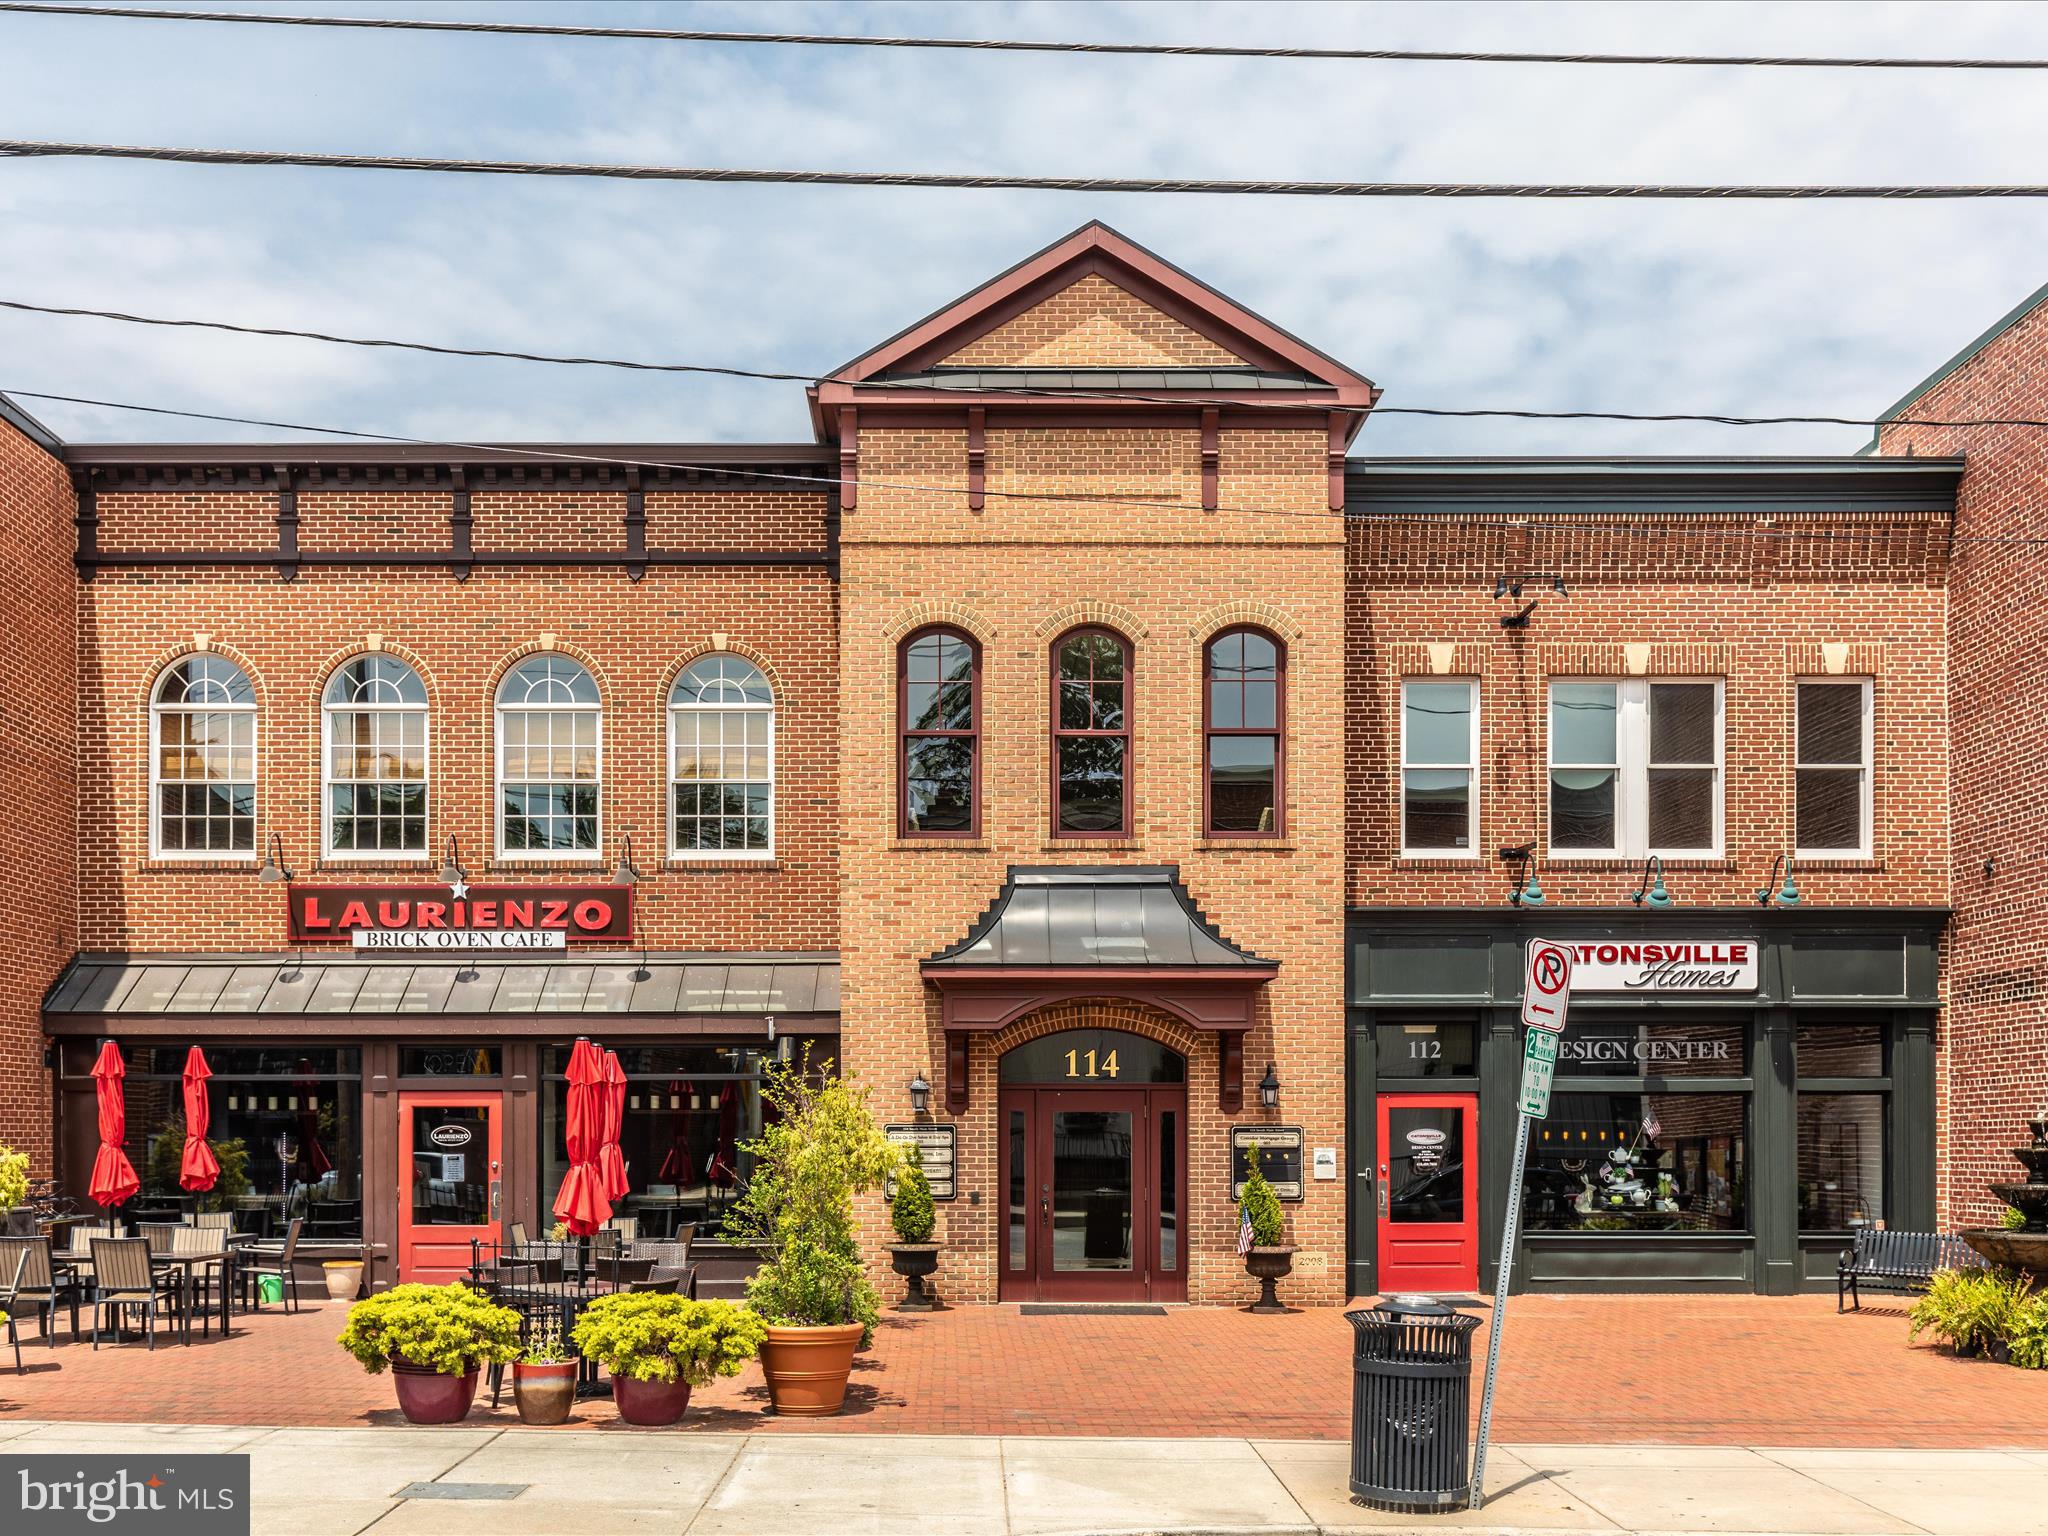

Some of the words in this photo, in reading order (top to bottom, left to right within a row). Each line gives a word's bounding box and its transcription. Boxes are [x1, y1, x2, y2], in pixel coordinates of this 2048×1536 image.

[304, 897, 613, 930] LAURIENZO
[366, 932, 428, 947] BRICK
[437, 932, 493, 947] OVEN
[500, 932, 553, 947] CAFE
[1569, 945, 1748, 963] ATONSVILLE
[1624, 958, 1740, 988] Homes
[1527, 1033, 1536, 1054] 2
[1541, 1035, 1551, 1046] HR
[1408, 1041, 1442, 1059] 112
[1535, 1045, 1554, 1059] PARKING
[1557, 1041, 1628, 1059] ESIGN
[1633, 1041, 1729, 1059] CENTER
[1064, 1049, 1120, 1077] 114
[1540, 1063, 1549, 1075] AM
[1533, 1074, 1540, 1087] TO
[1539, 1089, 1547, 1101] PM
[1299, 1257, 1323, 1266] 2008
